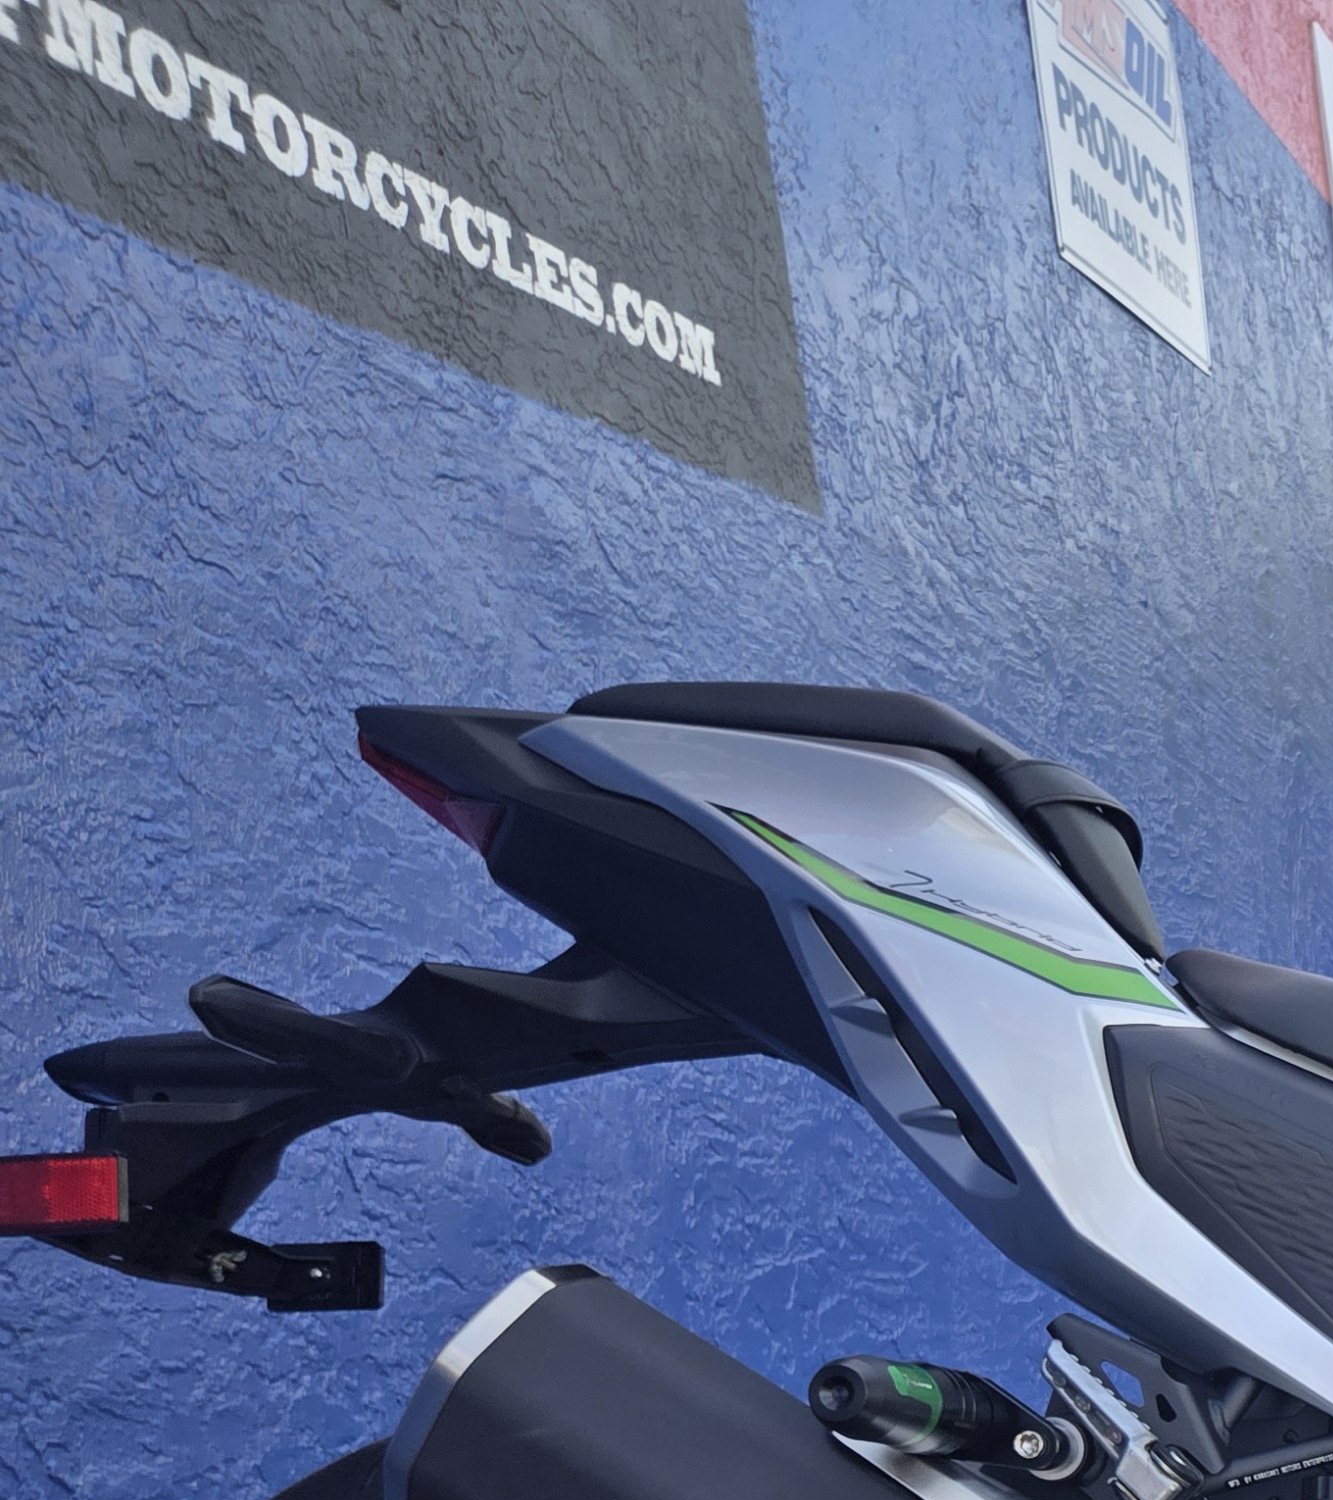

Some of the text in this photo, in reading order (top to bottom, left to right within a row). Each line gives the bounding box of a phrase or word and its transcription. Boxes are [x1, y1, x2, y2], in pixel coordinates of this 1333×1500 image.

[1124, 17, 1172, 128] OIL
[1051, 62, 1186, 246] PRODUCTS
[1070, 168, 1193, 310] AVAILABLE HERE
